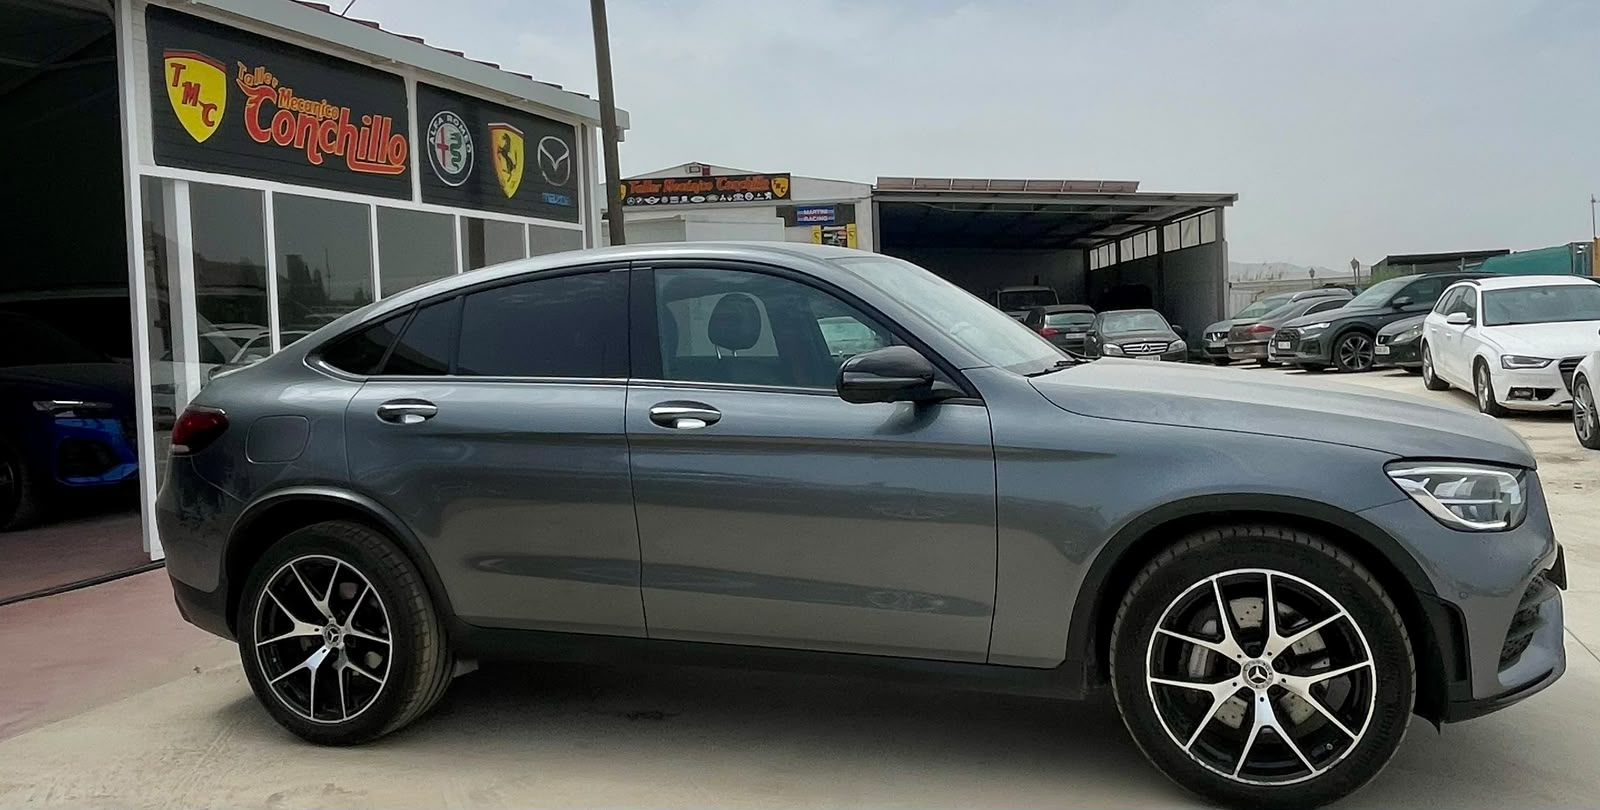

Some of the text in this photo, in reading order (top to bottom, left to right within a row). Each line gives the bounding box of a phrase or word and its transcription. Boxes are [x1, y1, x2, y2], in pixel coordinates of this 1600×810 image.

[237, 61, 339, 120] Taller Mecanico
[236, 79, 407, 174] Conchillo
[429, 115, 472, 153] ALFA ROMEO
